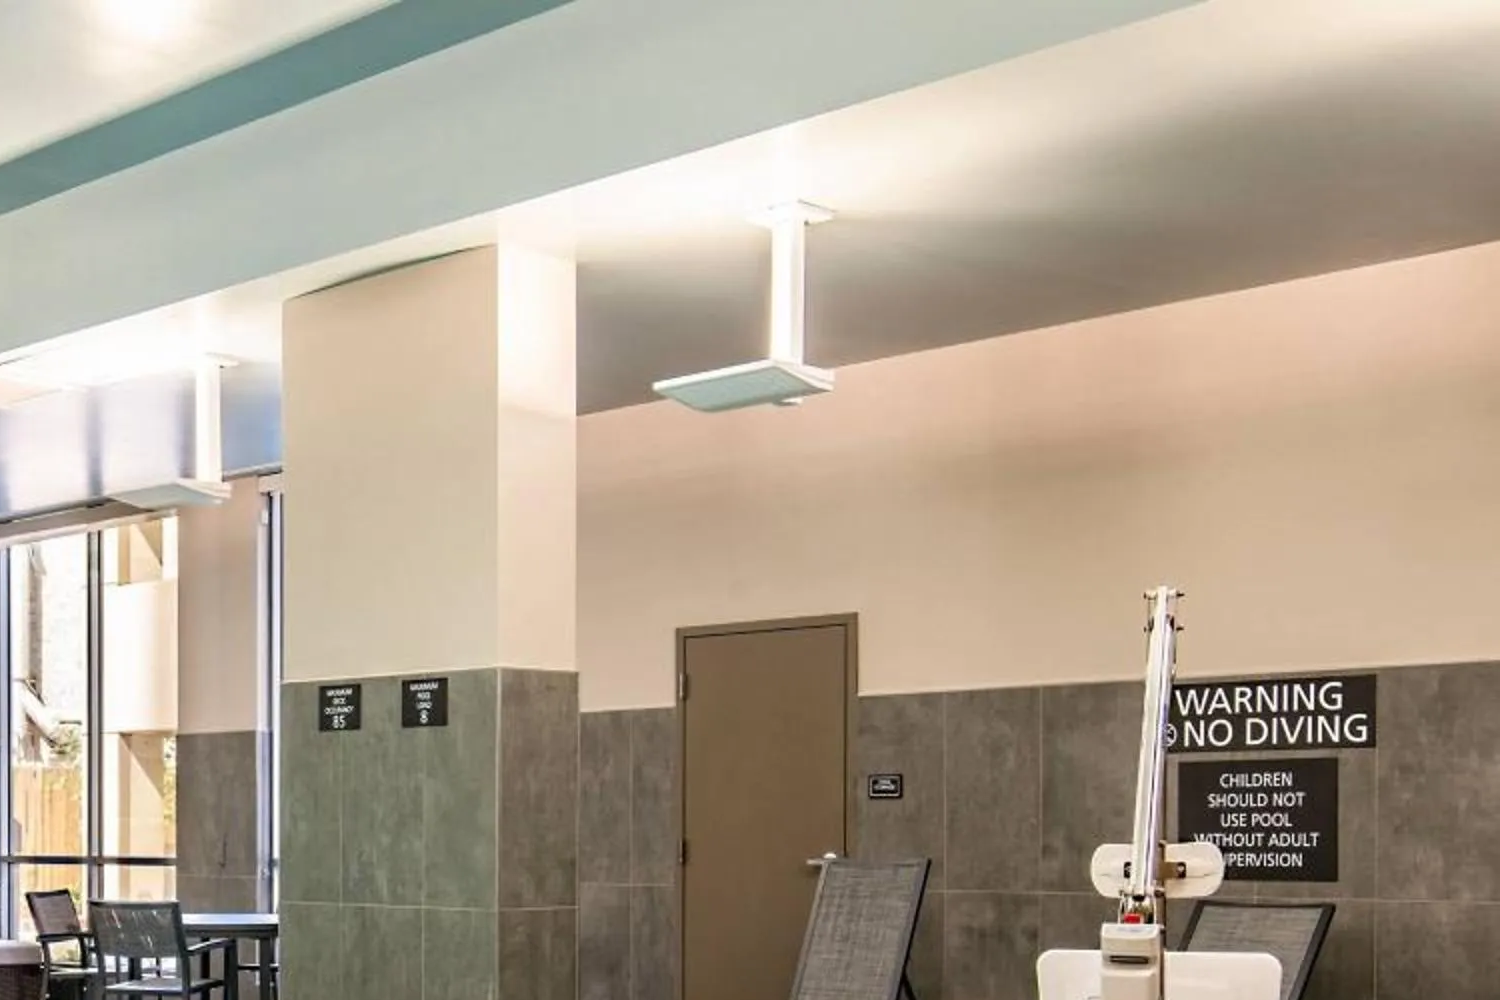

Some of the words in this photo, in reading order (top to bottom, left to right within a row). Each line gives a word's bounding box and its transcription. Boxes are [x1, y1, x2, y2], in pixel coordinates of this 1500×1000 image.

[1174, 682, 1344, 716] WARNING
[1184, 719, 1234, 747] NO
[1245, 714, 1368, 745] DIVING
[1219, 772, 1293, 788] CHILDREN
[1207, 793, 1268, 808] SHOULD
[1272, 792, 1306, 807] NOT
[1220, 814, 1247, 828] USE
[1251, 813, 1293, 827] POOL
[1268, 832, 1321, 847] ADULT
[1223, 852, 1303, 868] PERVISION
